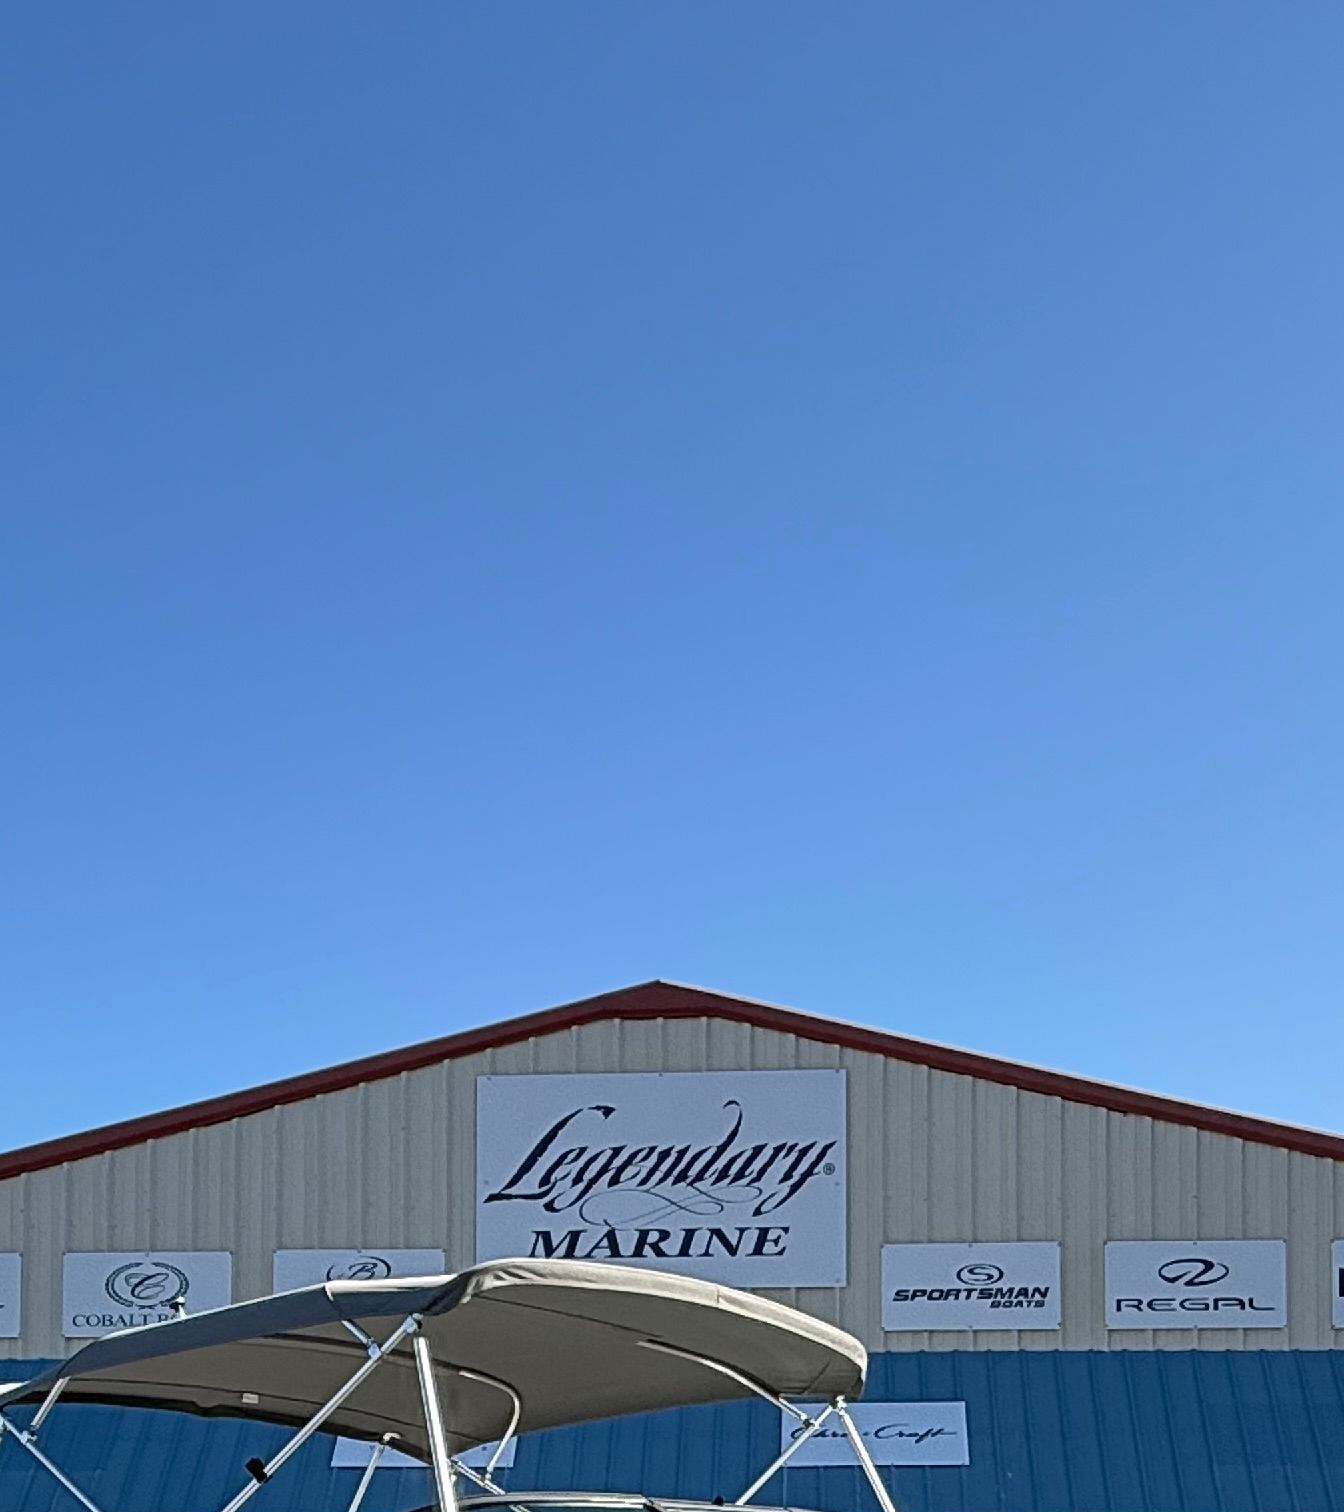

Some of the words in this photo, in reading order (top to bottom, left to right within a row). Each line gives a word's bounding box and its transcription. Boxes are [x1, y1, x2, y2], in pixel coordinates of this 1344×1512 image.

[483, 1100, 837, 1230] Legendary
[528, 1226, 790, 1259] MARINE
[892, 1287, 1050, 1302] SPORTSMAN
[989, 1300, 1046, 1308] BOATS
[1116, 1297, 1275, 1312] REGAL
[72, 1313, 153, 1328] COBALT
